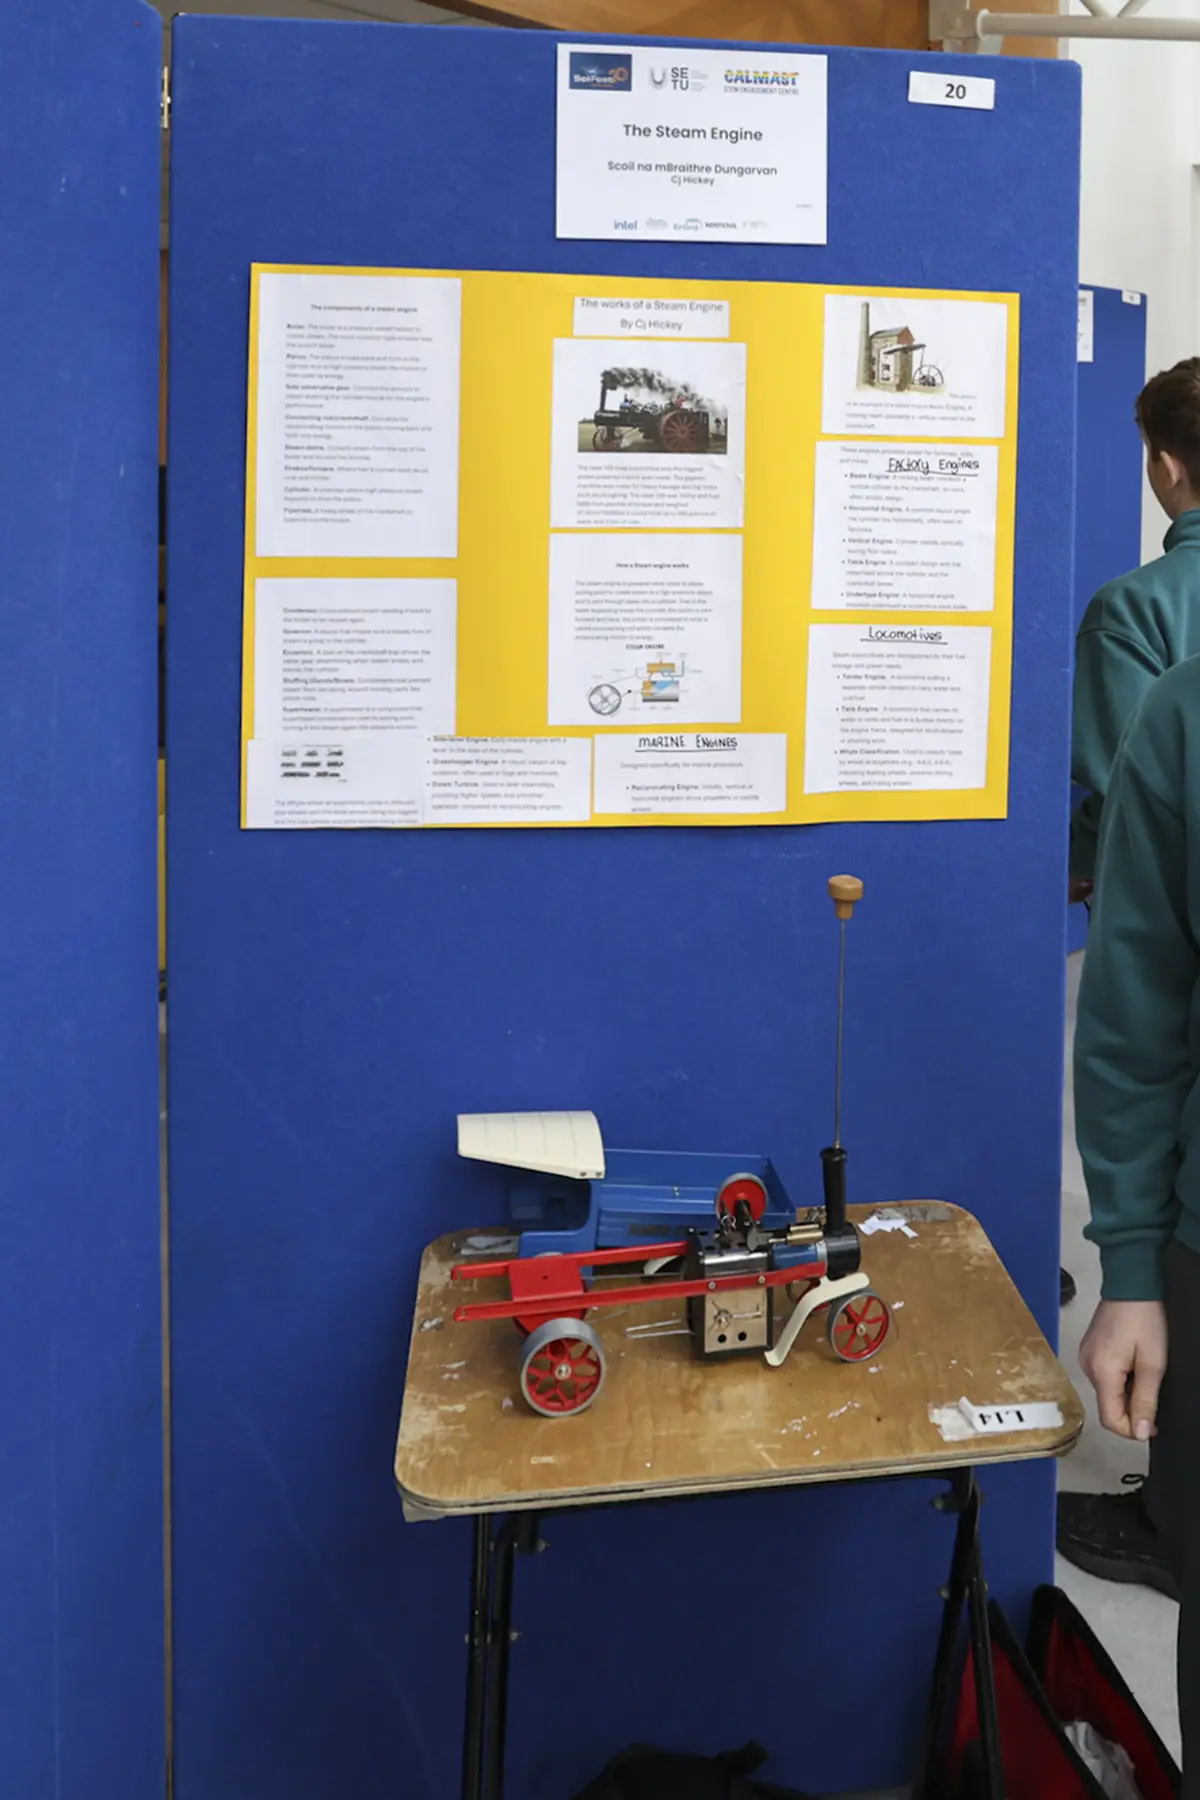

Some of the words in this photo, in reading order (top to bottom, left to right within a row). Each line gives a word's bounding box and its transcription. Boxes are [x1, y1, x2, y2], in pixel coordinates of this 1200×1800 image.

[671, 67, 689, 80] SE
[724, 69, 799, 87] CALMAST
[671, 79, 689, 92] TU
[944, 83, 967, 100] 20
[622, 123, 652, 138] The
[655, 125, 707, 140] Steam
[710, 126, 763, 144] Engine
[607, 161, 635, 172] Scoil
[637, 163, 652, 172] na
[655, 162, 713, 174] mBraithre
[714, 163, 777, 177] Dungarvan
[670, 175, 682, 186] Cj
[683, 176, 715, 187] Hickey
[613, 219, 638, 231] intel
[580, 298, 599, 309] The
[601, 299, 631, 310] works
[633, 299, 644, 310] of
[645, 303, 652, 311] a
[653, 301, 687, 311] Steam
[688, 302, 724, 314] Engine
[620, 319, 633, 330] By
[634, 319, 647, 331] Cj
[648, 320, 684, 332] Hickey
[938, 455, 980, 476] Engines
[868, 625, 942, 642] Locomotives
